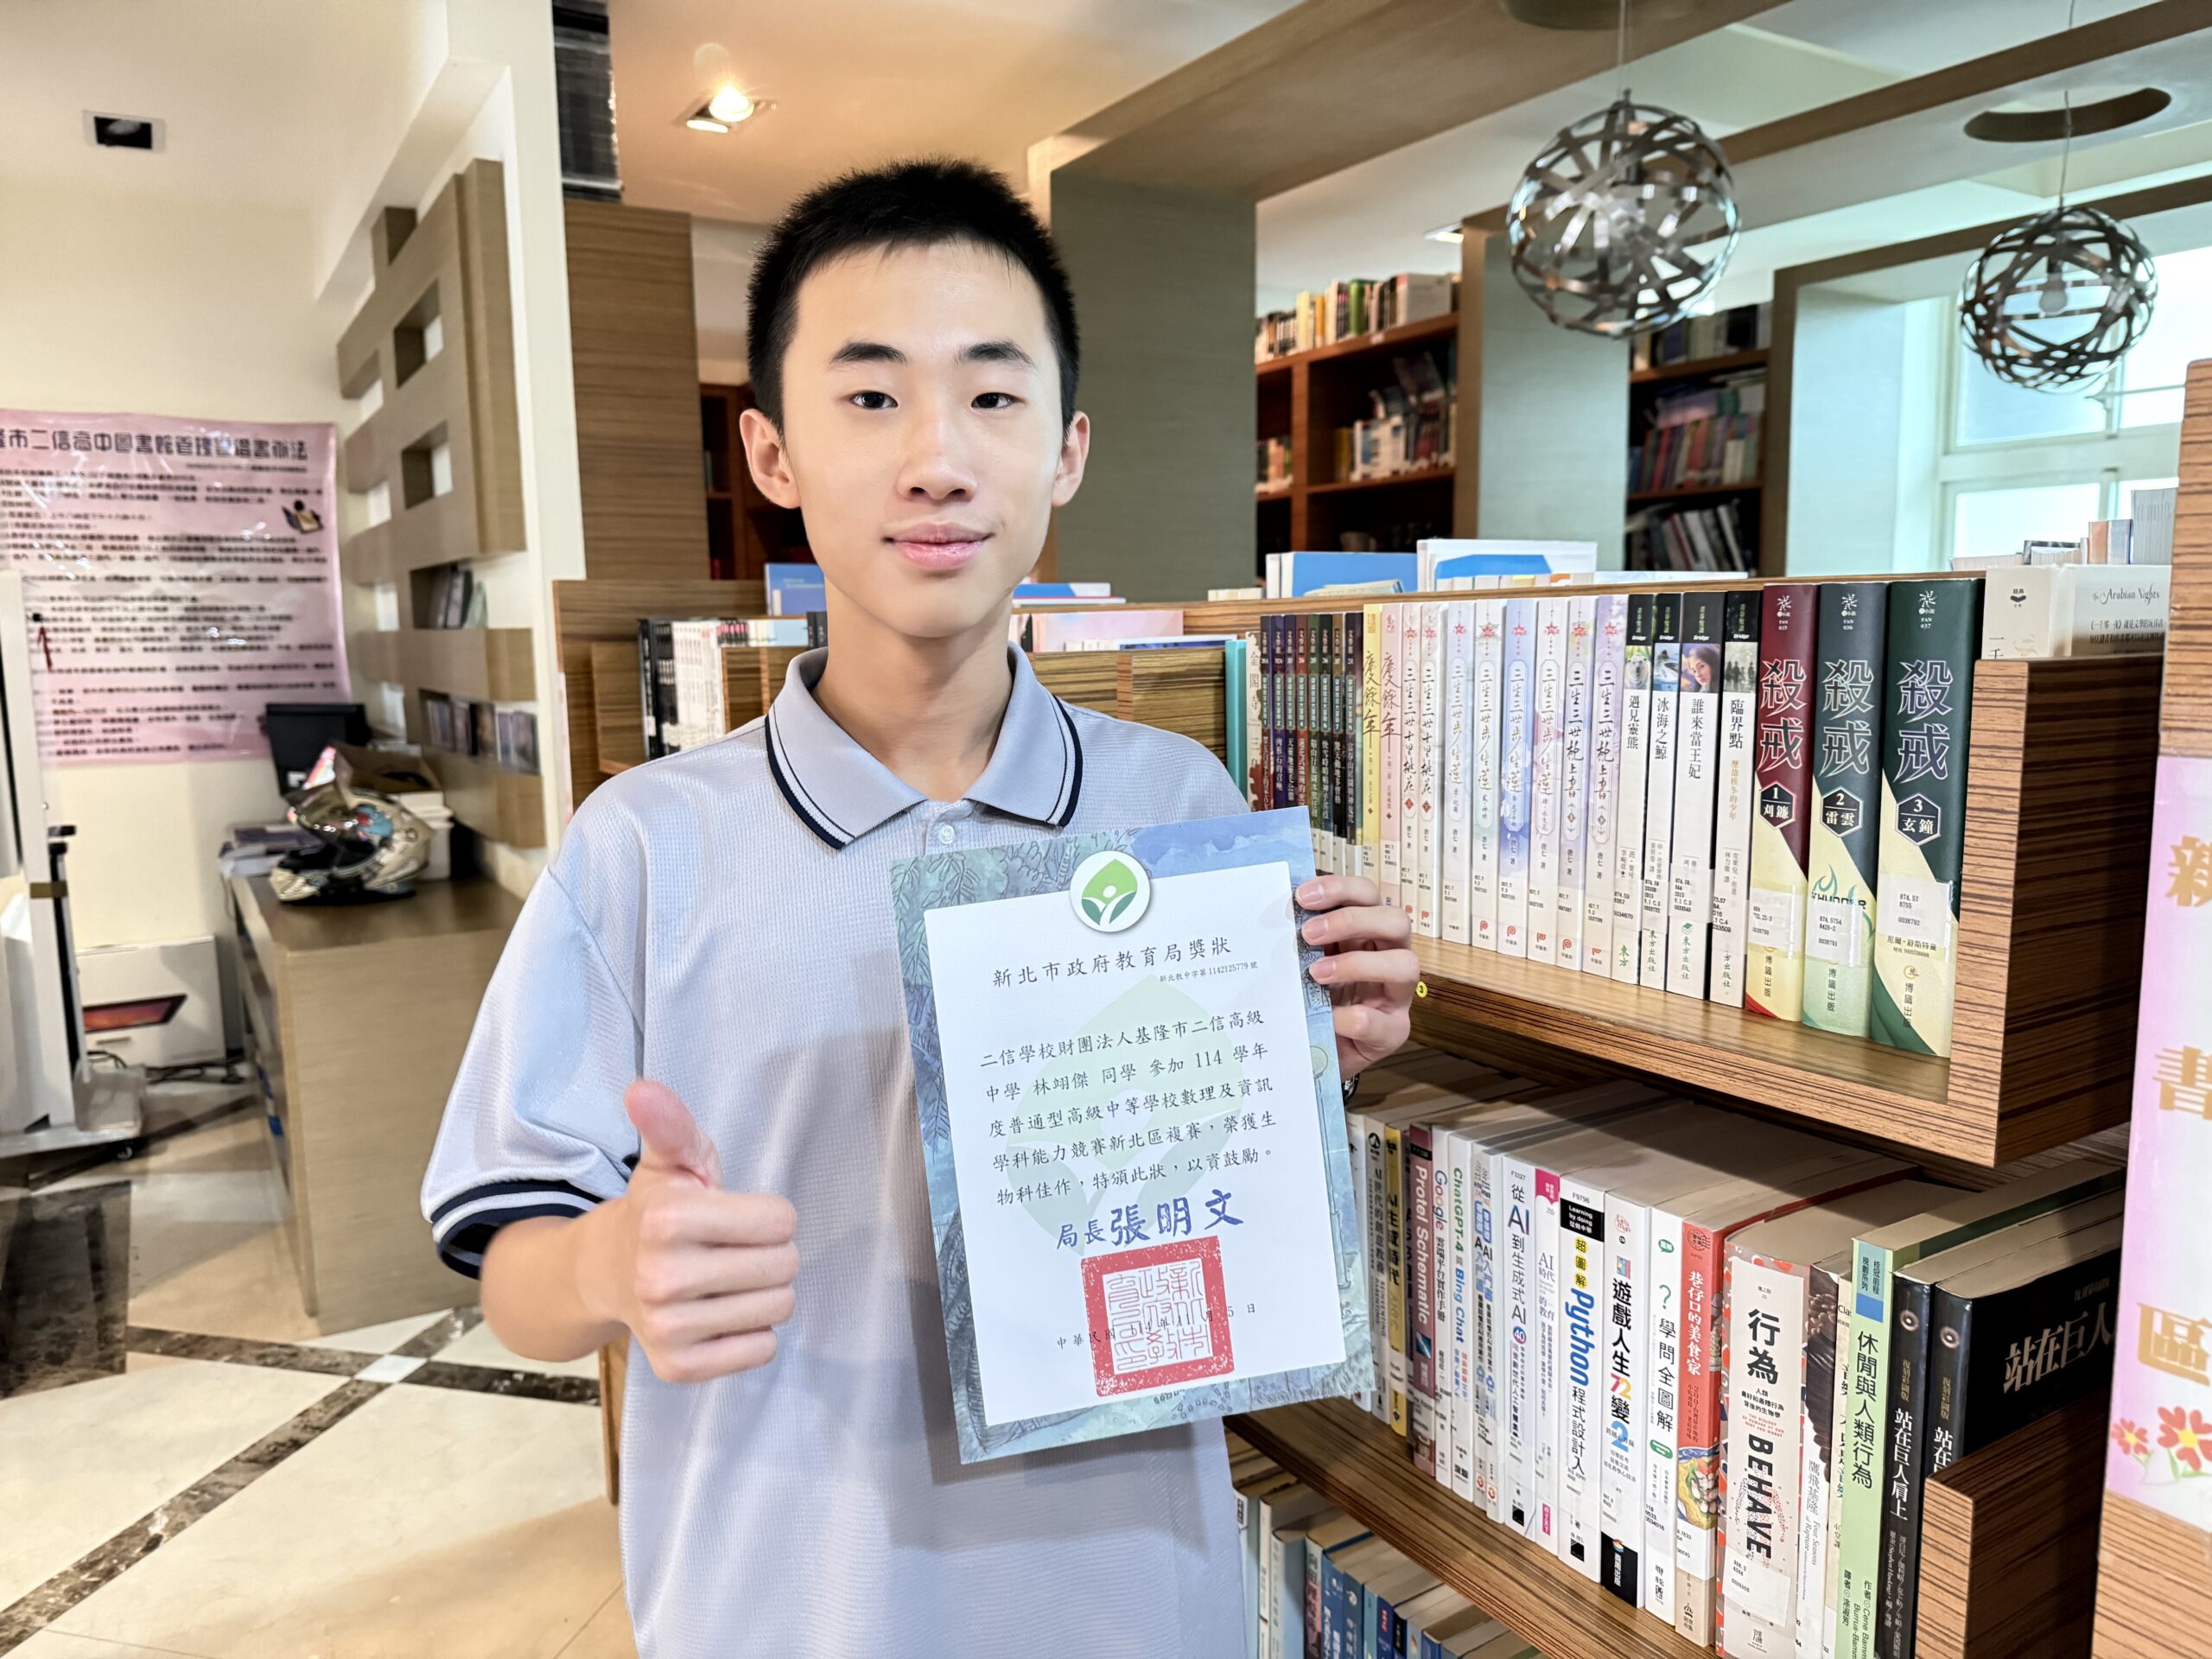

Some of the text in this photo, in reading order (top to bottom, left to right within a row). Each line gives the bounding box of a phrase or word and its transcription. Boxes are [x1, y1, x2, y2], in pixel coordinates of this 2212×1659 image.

[2100, 588, 2135, 606] Arabian
[1403, 668, 1417, 793] 三生三世十里桃花
[1421, 669, 1435, 795] 三生三世十里桃花
[1450, 665, 1465, 785] 三生三世步生蓮
[1476, 669, 1492, 791] 三生三世步生蓮
[1507, 668, 1524, 793] 三生三世步生蓮
[1536, 668, 1555, 796] 三生三世步生蓮
[1564, 671, 1585, 798] 三生三世枕上書
[1593, 670, 1615, 800] 三生三世枕上書
[1626, 695, 1640, 750] 遇見靈熊
[1655, 696, 1669, 760] 冰海之鯨
[1688, 697, 1704, 779] 誰來當王妃
[1728, 698, 1744, 750] 臨界點
[1760, 658, 1808, 772] 殺戒
[1821, 658, 1875, 779] 殺戒
[1892, 659, 1954, 784] 殺戒
[1772, 787, 1779, 799] 1
[1826, 810, 1856, 827] 雷雲
[1836, 793, 1845, 805] 2
[1913, 799, 1923, 813] 3
[1902, 818, 1934, 835] 玄鐘
[1897, 917, 1920, 926] 0036792
[1899, 893, 1919, 902] 874.57
[992, 936, 1231, 988] 新北市政府教育局獎狀
[1159, 968, 1207, 983] 新北教中字第
[1208, 962, 1249, 976] 1142125779
[1618, 944, 1630, 967] 東方
[1647, 930, 1656, 972] 東方出版社
[1681, 936, 1691, 980] 東方出版社
[1721, 951, 1732, 988] 方出版社
[1903, 982, 1914, 1028] 博識出版
[979, 1008, 1266, 1069] 二信學校財團法人基隆市二信高級
[985, 1041, 1268, 1104] 中學 林翊傑 同學 參加 114 學年
[988, 1077, 1274, 1139] 度普通型高級中等學校數理及資訊
[992, 1109, 1277, 1173] 學科能力競賽新北區複賽，榮獲生
[996, 1147, 1273, 1206] 物科佳作，特頒此狀，以資鼓勵。
[1433, 1169, 1448, 1230] Google
[1572, 1192, 1590, 1205] F9796
[1453, 1167, 1464, 1252] ChatGPT-4
[1568, 1205, 1593, 1220] Learning
[1577, 1214, 1593, 1227] doing
[1415, 1165, 1431, 1325] Protel Schematic
[1538, 1253, 1554, 1271] AI
[1574, 1237, 1588, 1289] 超圖解
[1452, 1268, 1466, 1303] Bing
[1538, 1268, 1555, 1283] 時代
[1247, 1303, 1256, 1314] 日
[1455, 1306, 1465, 1344] Chat
[1564, 1287, 1595, 1387] Python
[1687, 1270, 1704, 1376] 巷仔口的美食家
[1656, 1317, 1676, 1433] 學問全圖解
[1746, 1307, 1781, 1386] 行為
[2003, 1302, 2116, 1395] 站在巨人
[1741, 1389, 1785, 1412] 最好和最糟行為
[1743, 1400, 1782, 1419] 背後的生物學
[1755, 1387, 1769, 1397] 人類
[1852, 1331, 1879, 1490] 休閒與人類行為
[1891, 1407, 1913, 1521] 站在巨人肩上
[1746, 1433, 1774, 1560] BEHAVE
